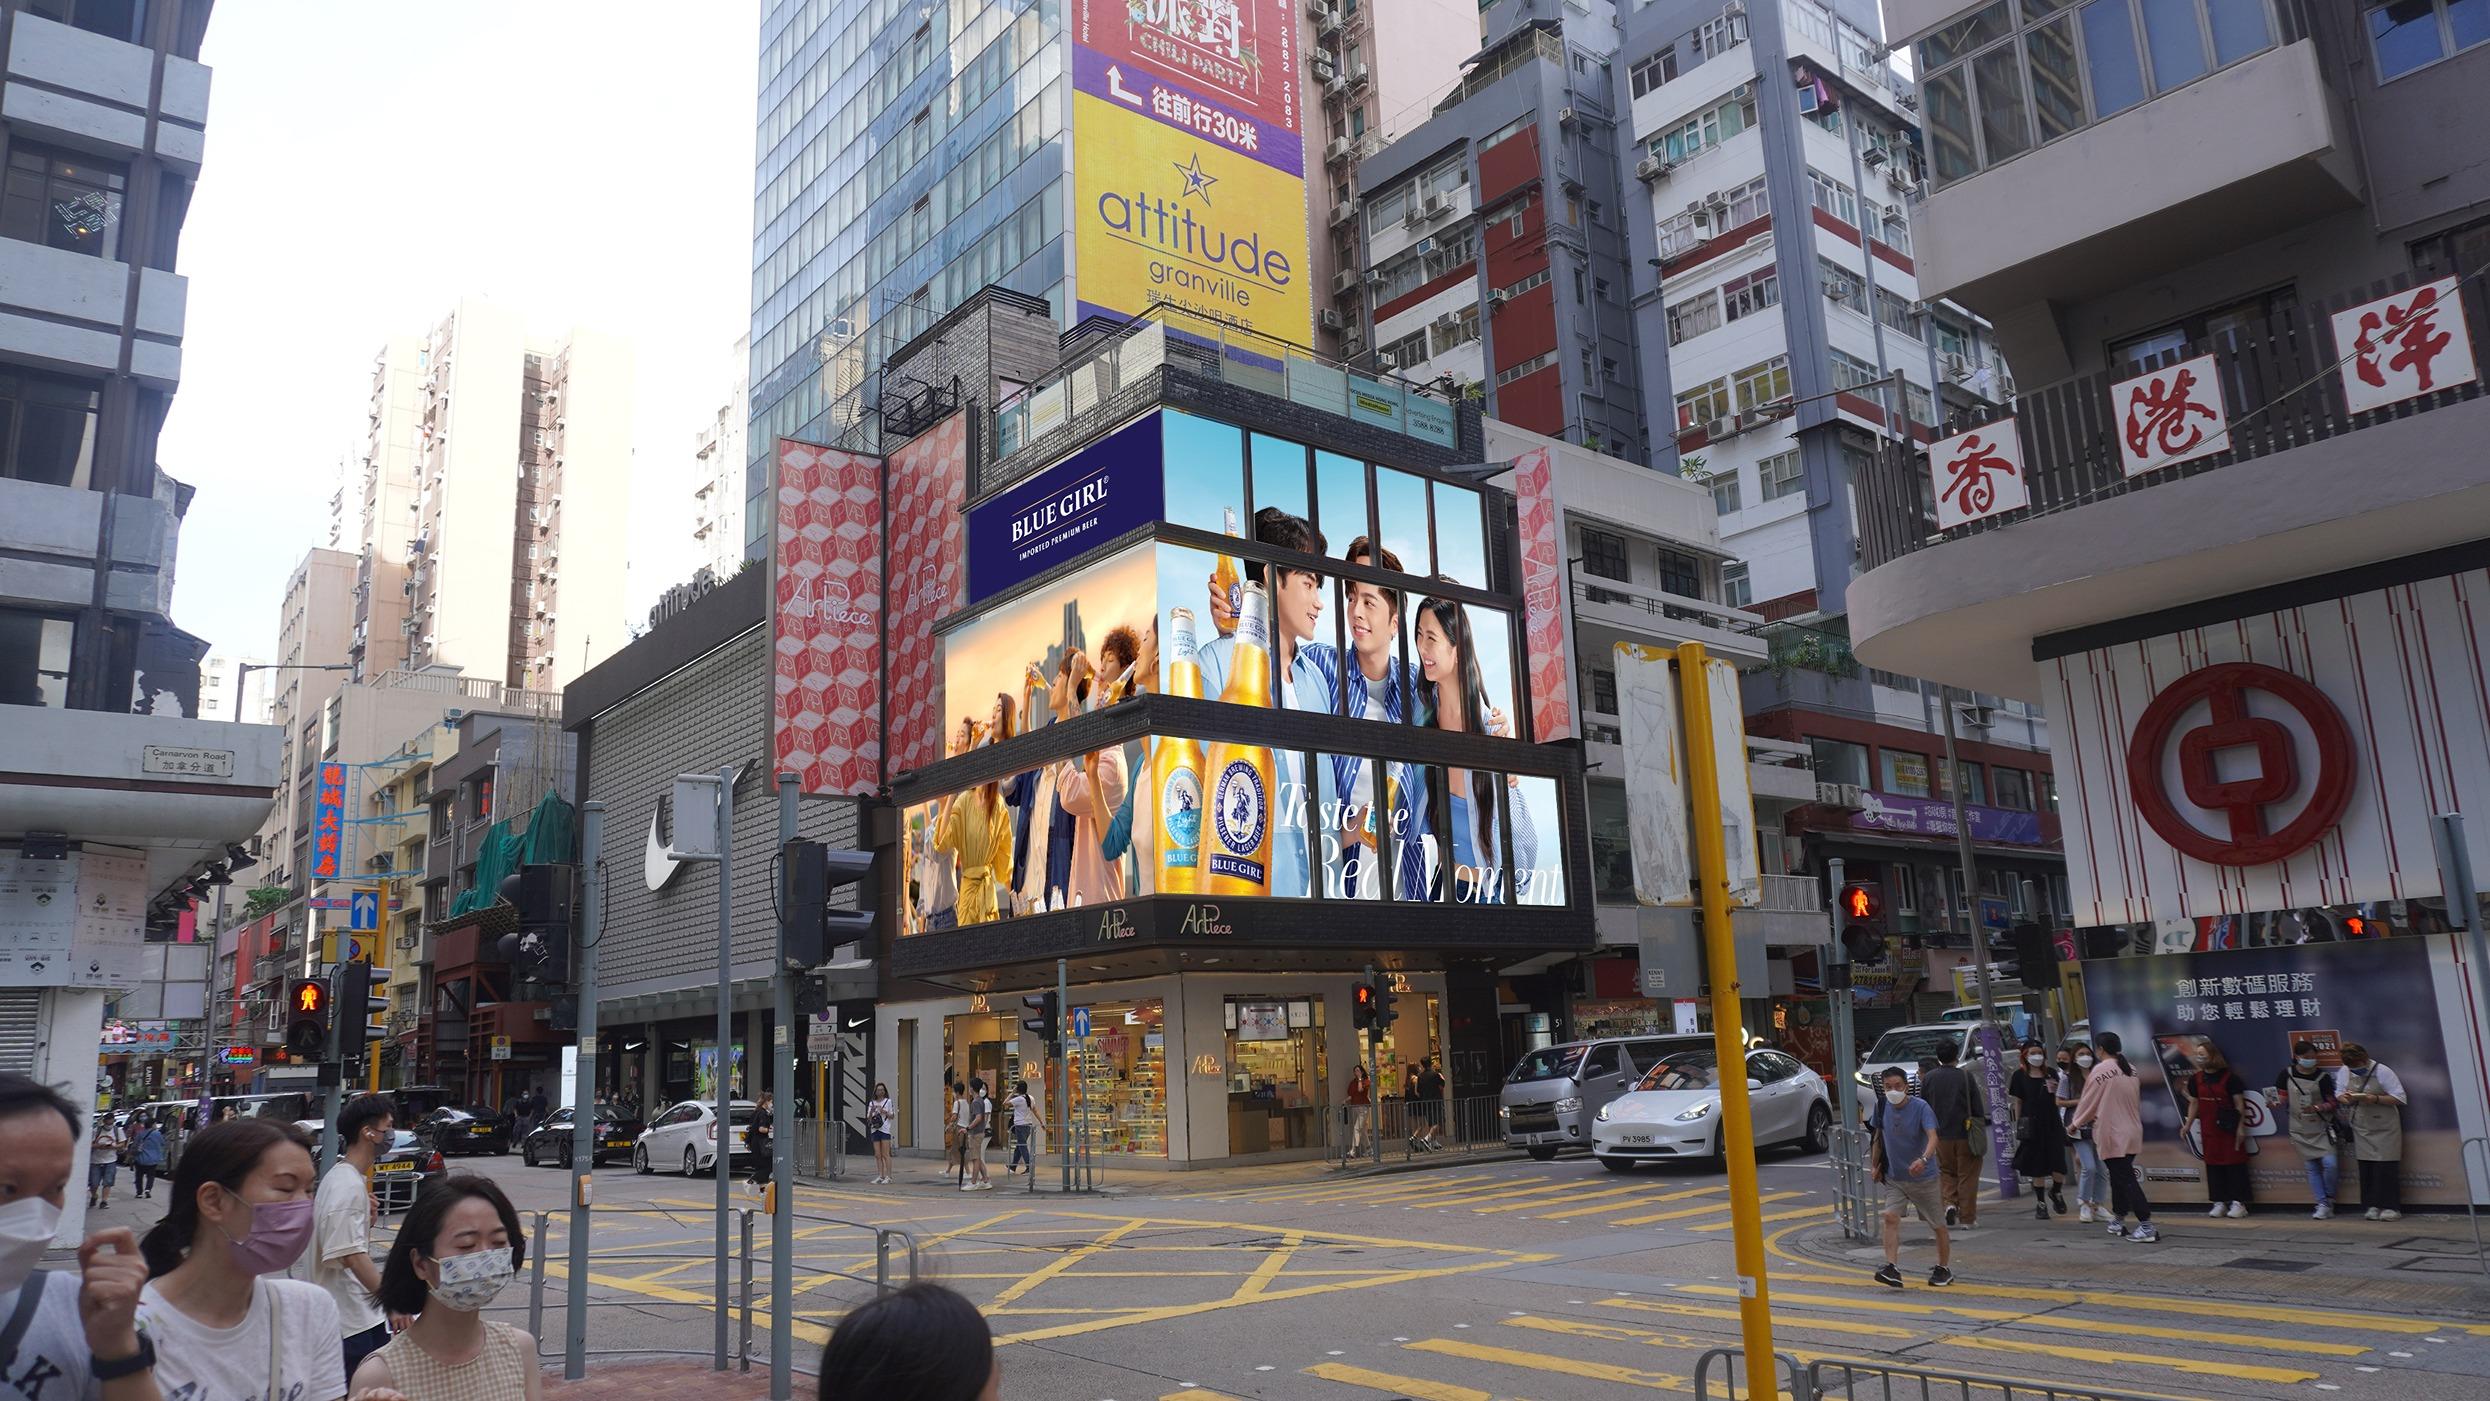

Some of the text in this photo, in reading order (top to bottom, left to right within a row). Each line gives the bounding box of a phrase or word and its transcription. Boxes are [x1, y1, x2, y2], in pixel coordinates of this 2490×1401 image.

[1192, 53, 1248, 90] PARTY
[1281, 26, 1292, 128] 2882 2083
[1152, 86, 1257, 151] 往前行30米
[1098, 190, 1291, 286] attitude
[1149, 261, 1250, 307] granville
[1941, 434, 2016, 515] 香
[2126, 369, 2217, 458] 港
[1012, 502, 1057, 543] BLUE
[1019, 517, 1098, 561] IMPORTED PREMIUM BEER
[152, 748, 226, 761] Carnarvon Road
[162, 760, 215, 773] 加拿分道
[1167, 853, 1189, 864] BLUE
[1211, 858, 1238, 872] BLUE
[2174, 972, 2316, 998] 創新數碼服務
[2176, 998, 2321, 1022] 助您輕鬆理財
